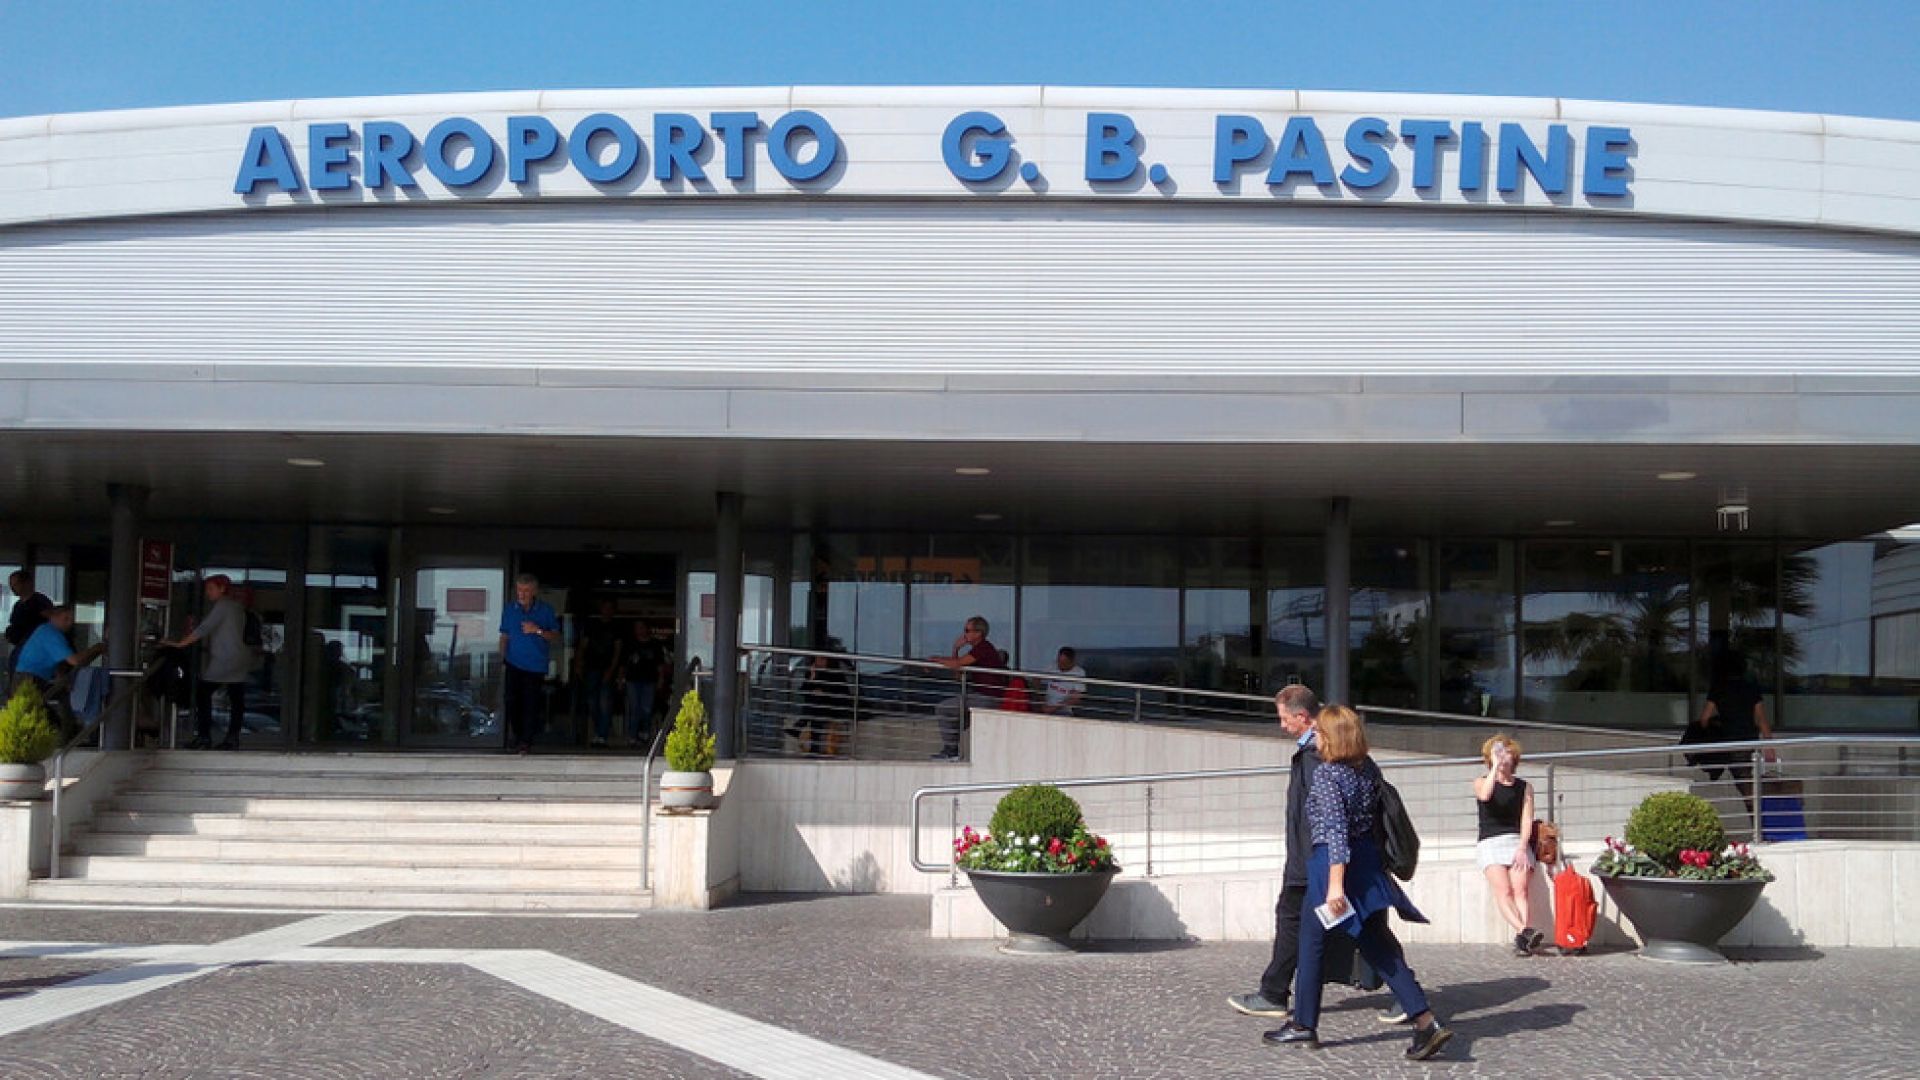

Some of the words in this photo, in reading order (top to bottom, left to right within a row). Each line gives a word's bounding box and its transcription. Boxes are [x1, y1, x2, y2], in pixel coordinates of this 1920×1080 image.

[233, 109, 838, 194] AEROPORTO
[942, 111, 1039, 182] G.
[1085, 112, 1167, 184] B.
[1213, 114, 1631, 196] PASTINE
